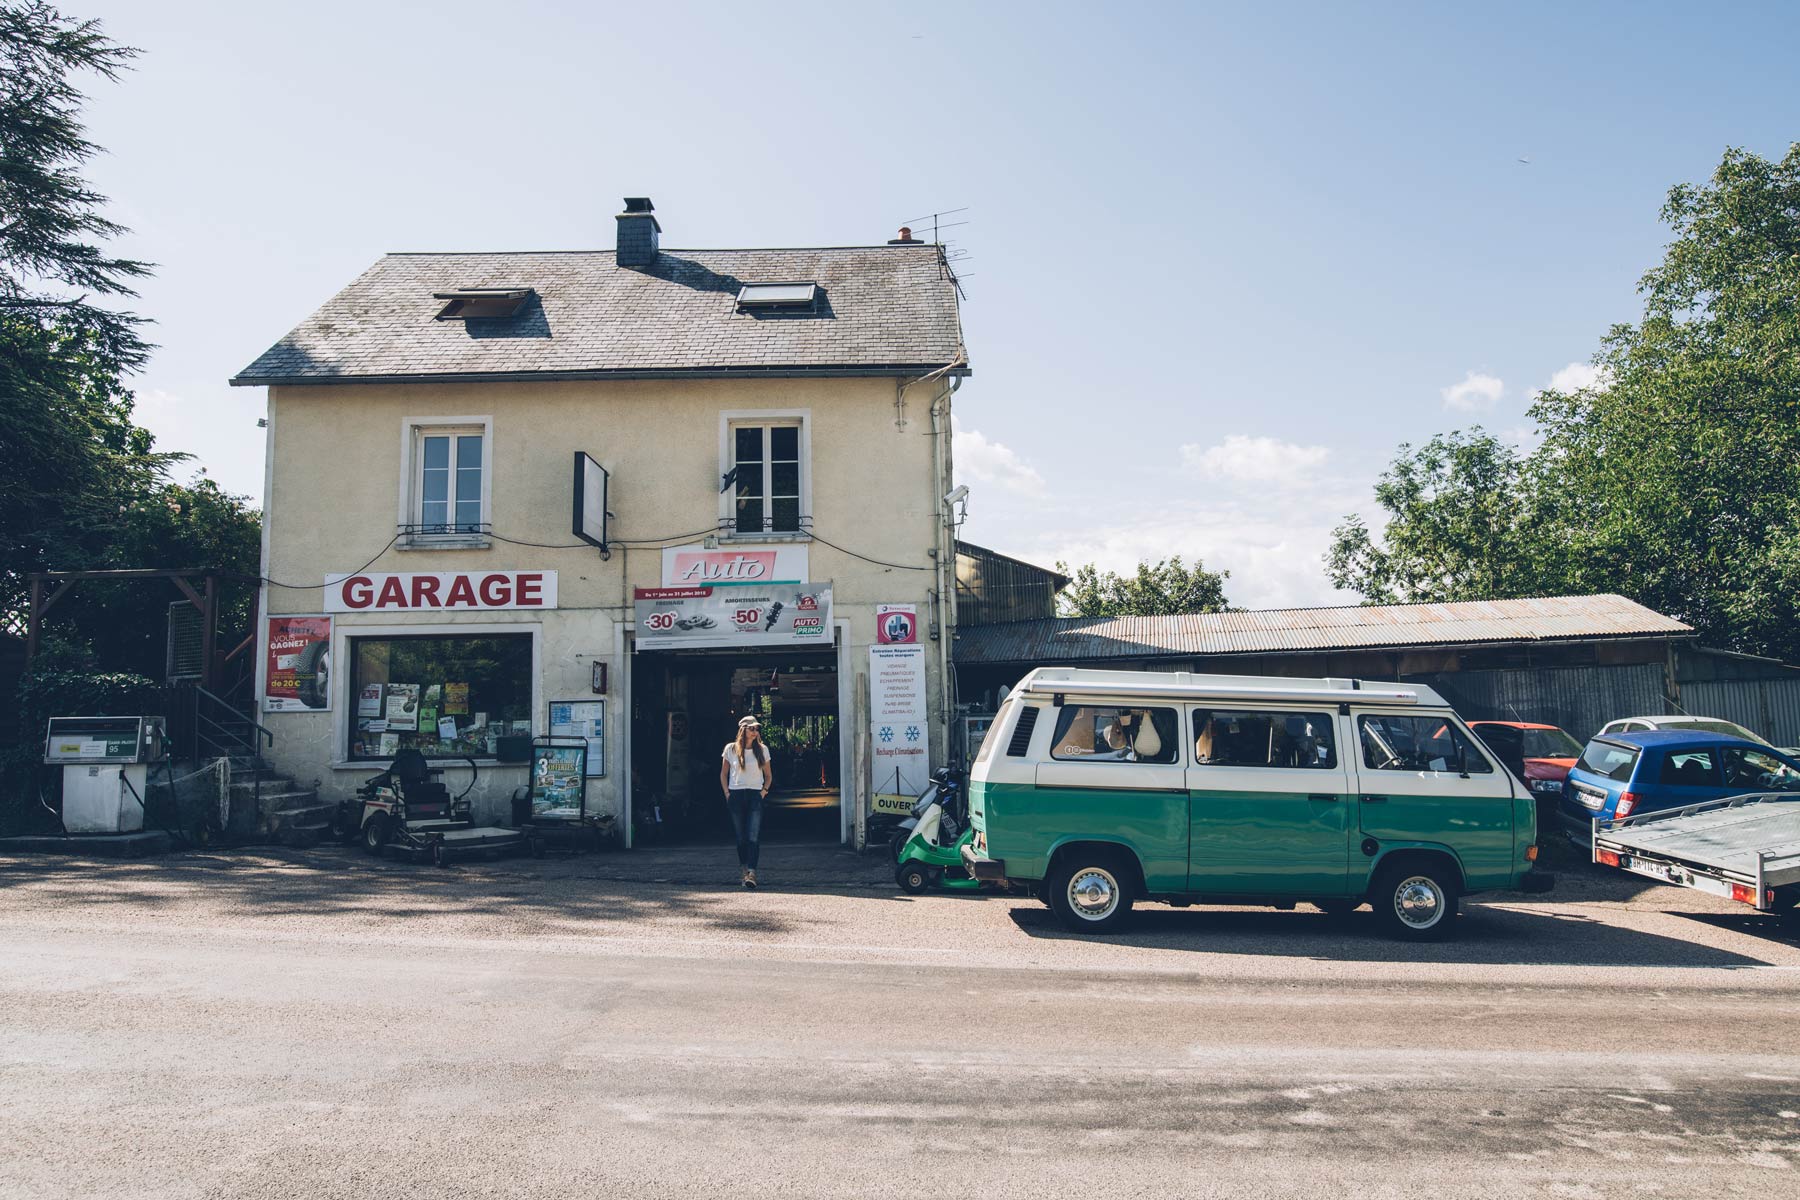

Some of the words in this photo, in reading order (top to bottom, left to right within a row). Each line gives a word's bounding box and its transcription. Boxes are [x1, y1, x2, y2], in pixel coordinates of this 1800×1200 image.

[683, 555, 765, 580] Auto
[342, 574, 543, 609] GARAGE
[794, 618, 818, 626] AUTO
[797, 626, 822, 634] PRIMO
[270, 640, 304, 649] GAGNEZ
[109, 745, 119, 753] 95
[538, 758, 548, 776] 3
